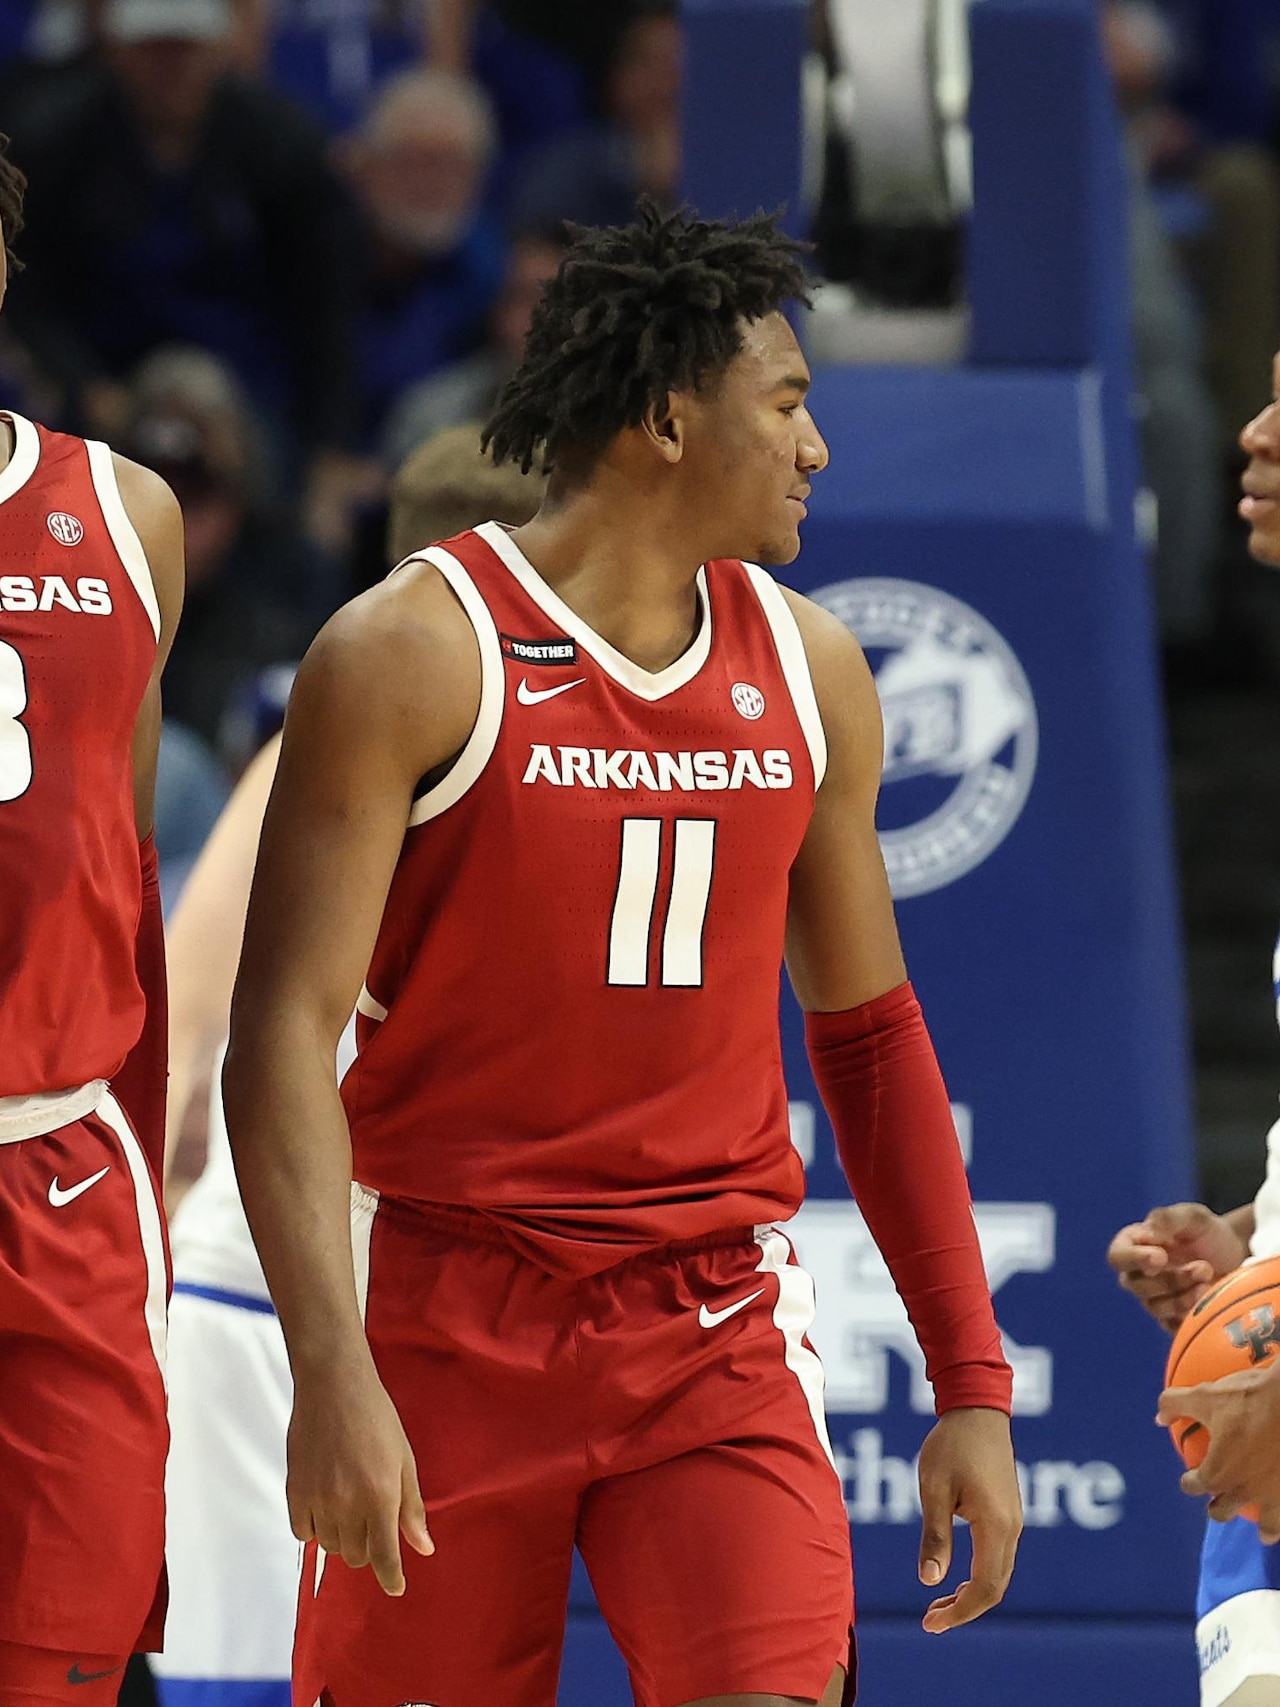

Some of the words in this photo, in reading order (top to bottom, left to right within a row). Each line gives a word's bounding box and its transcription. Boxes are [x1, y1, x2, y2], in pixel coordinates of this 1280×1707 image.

[49, 513, 82, 543] SEC
[512, 642, 575, 659] TOGETHER
[733, 685, 763, 717] SEC
[521, 743, 794, 792] ARKANSAS
[607, 817, 717, 989] 11
